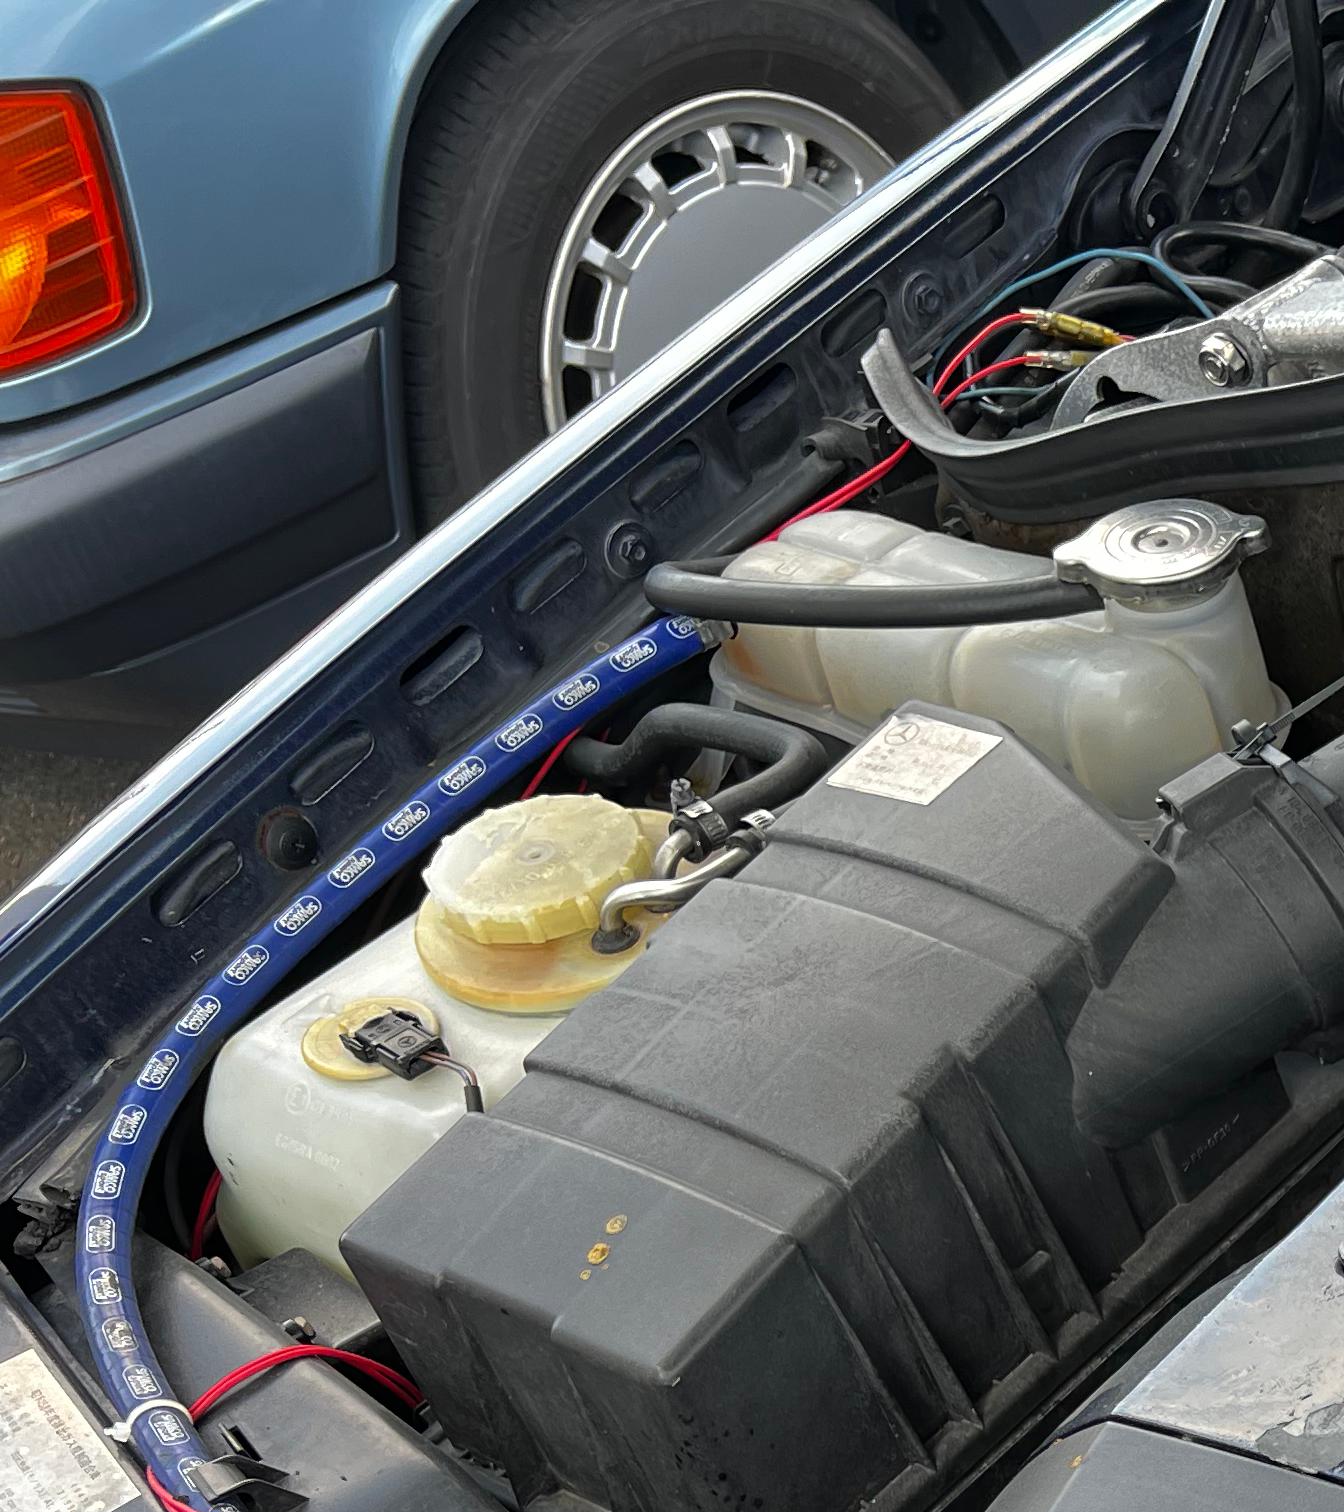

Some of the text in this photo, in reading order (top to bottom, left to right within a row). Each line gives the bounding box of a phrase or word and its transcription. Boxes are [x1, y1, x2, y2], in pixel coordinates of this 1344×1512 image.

[622, 643, 653, 668] SAMCO
[564, 681, 597, 706] SAMCO
[507, 722, 538, 748] SAMCO
[450, 763, 483, 790] SAMCO
[394, 807, 426, 836] SAMCO
[340, 854, 372, 883] SAMCO
[286, 901, 318, 931] SAMCO
[189, 1001, 217, 1031] SAMCO
[104, 1164, 122, 1193] SAMCO
